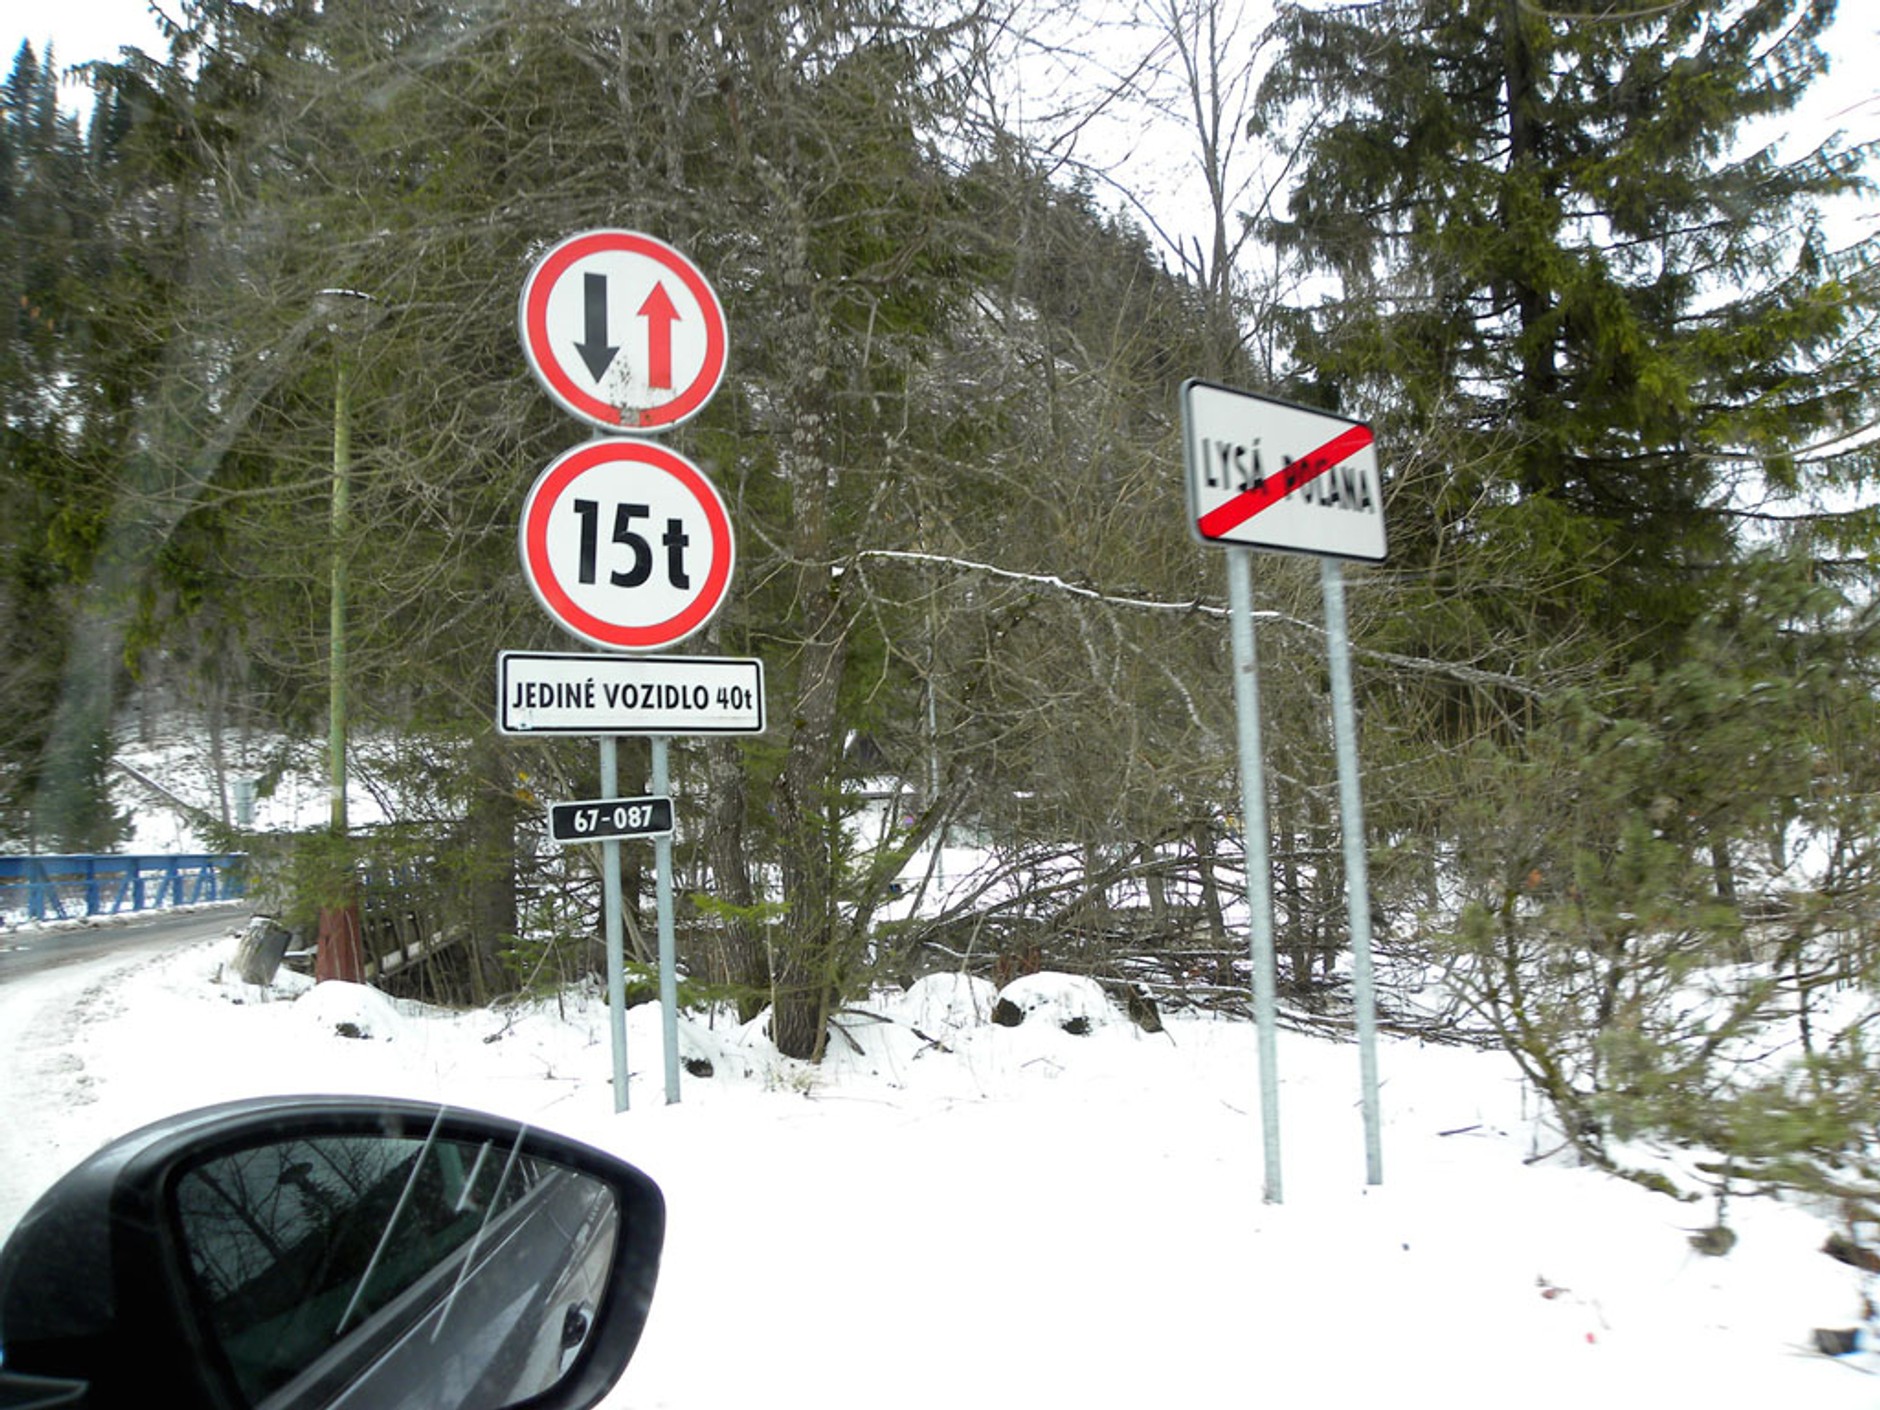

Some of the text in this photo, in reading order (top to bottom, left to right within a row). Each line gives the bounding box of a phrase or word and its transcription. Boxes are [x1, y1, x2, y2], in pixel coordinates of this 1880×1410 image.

[1202, 438, 1269, 494] LYSÁ
[574, 499, 690, 590] 15t
[512, 677, 753, 710] JEDINÉ VOZIDLO 40t
[573, 805, 653, 832] 67-087
